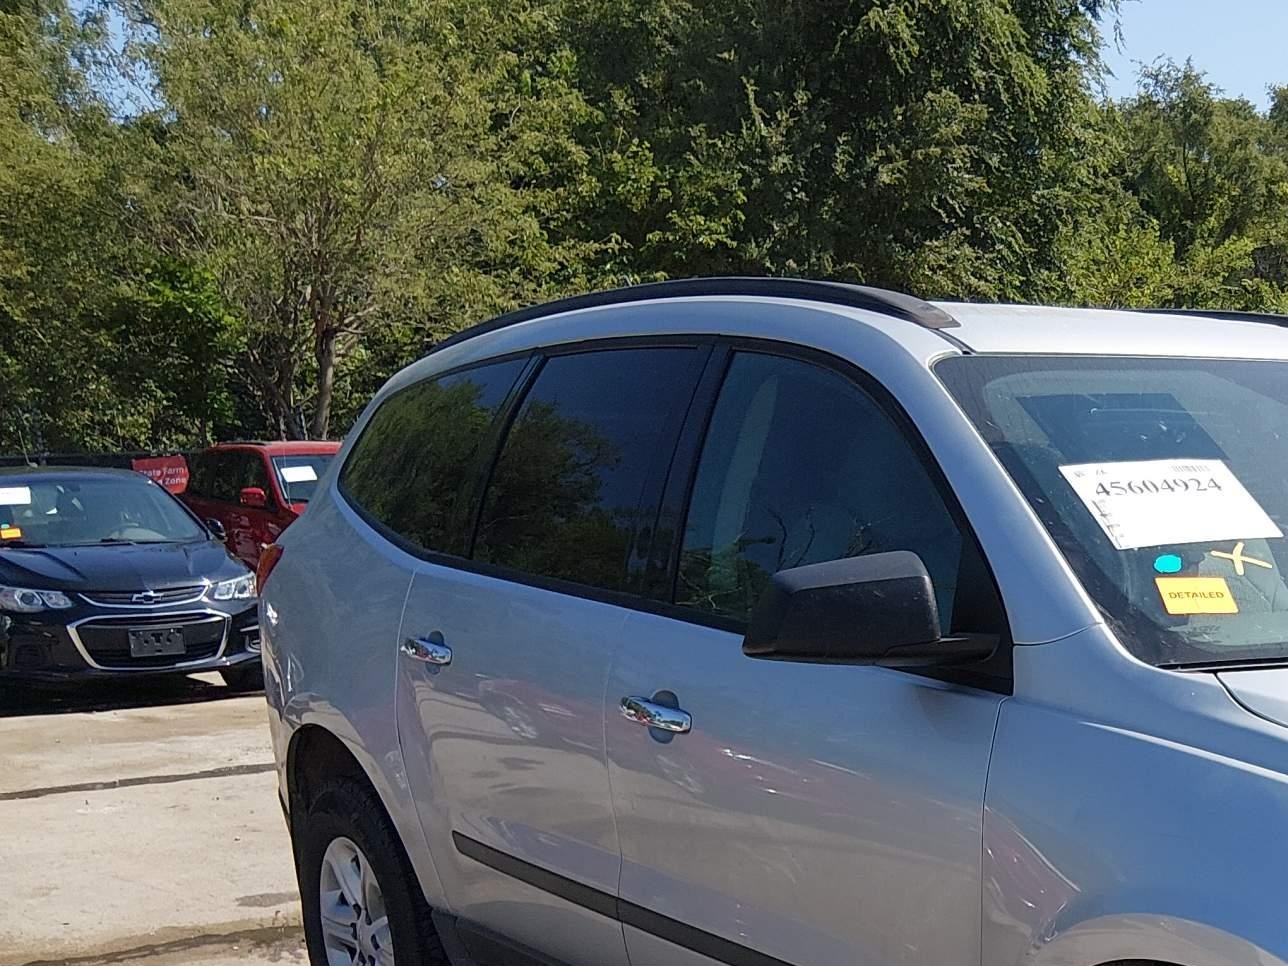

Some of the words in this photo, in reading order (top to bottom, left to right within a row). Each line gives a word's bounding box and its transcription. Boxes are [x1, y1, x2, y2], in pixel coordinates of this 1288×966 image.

[163, 467, 185, 476] Farm
[1095, 478, 1222, 496] 45604924
[1168, 591, 1224, 599] DETAILED
